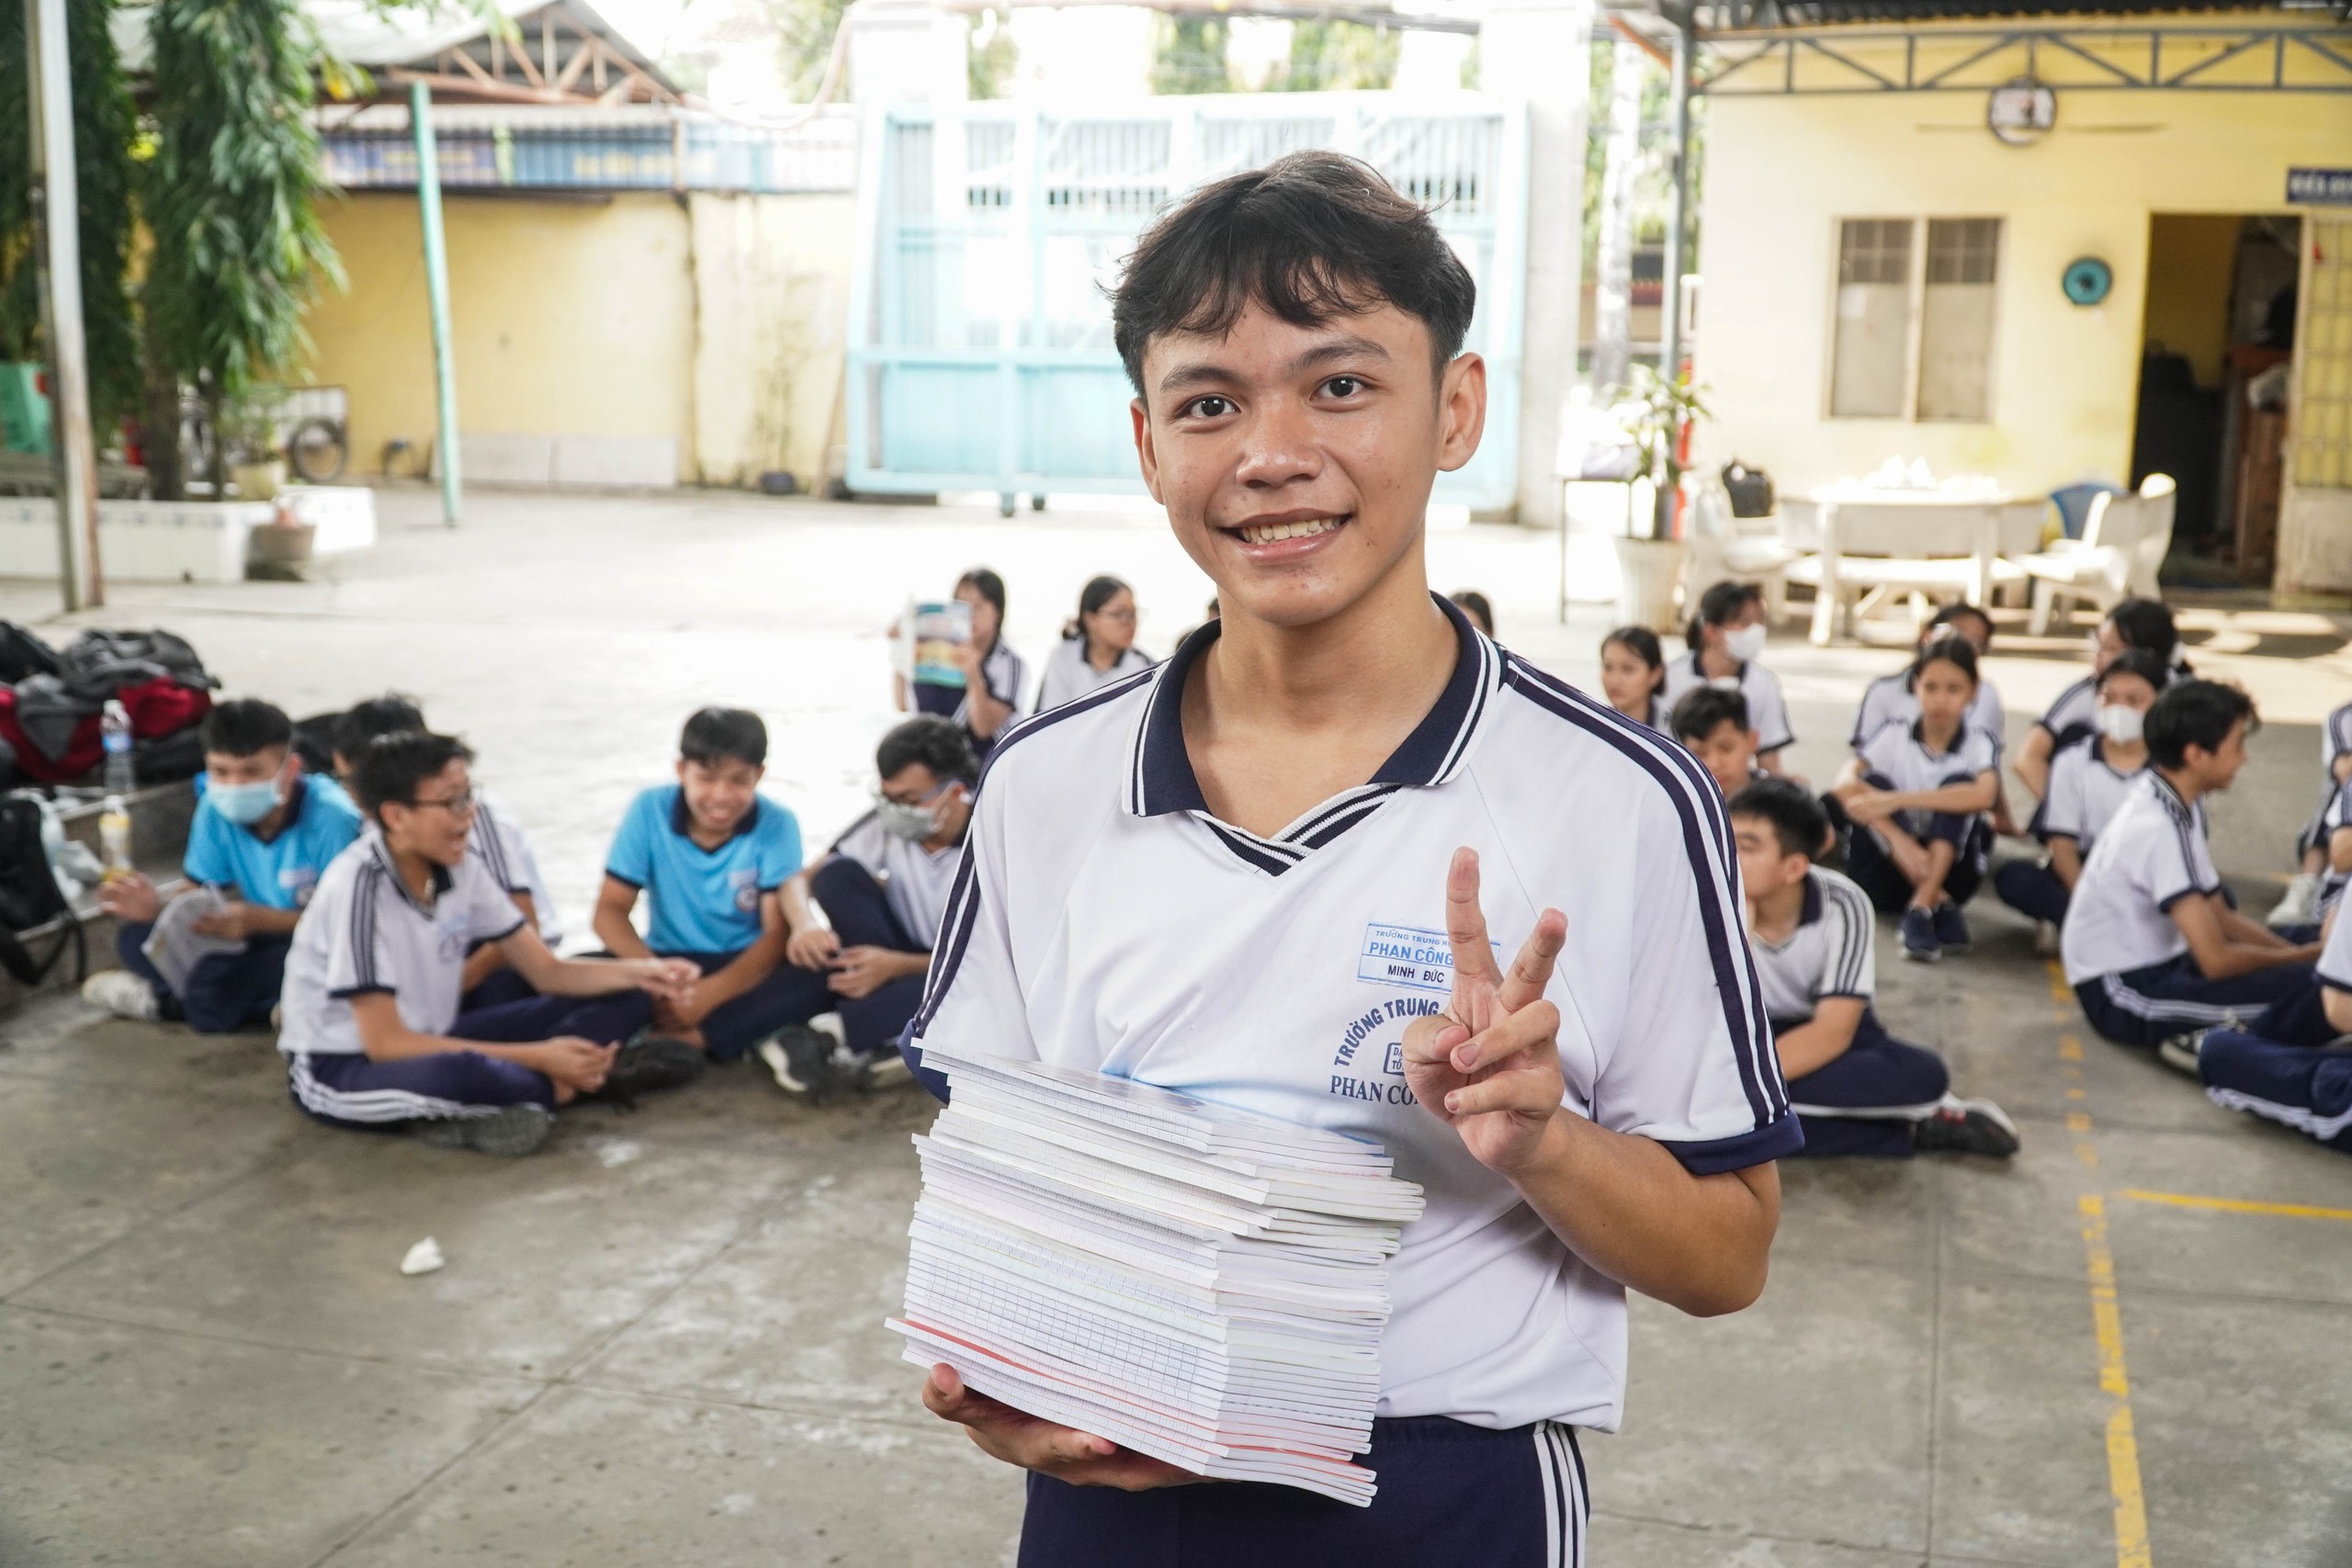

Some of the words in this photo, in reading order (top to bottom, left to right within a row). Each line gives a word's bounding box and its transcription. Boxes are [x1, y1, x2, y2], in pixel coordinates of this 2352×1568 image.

[1412, 935, 1440, 945] TRUNG
[1369, 942, 1412, 959] PHAN
[1415, 947, 1454, 965] CÔNG
[1387, 964, 1415, 978] MINH
[1423, 969, 1444, 983] ĐỨC
[1334, 1008, 1385, 1066] TRƯỜNG
[1384, 998, 1440, 1019] TRUNG
[1329, 1075, 1384, 1102] PHAN
